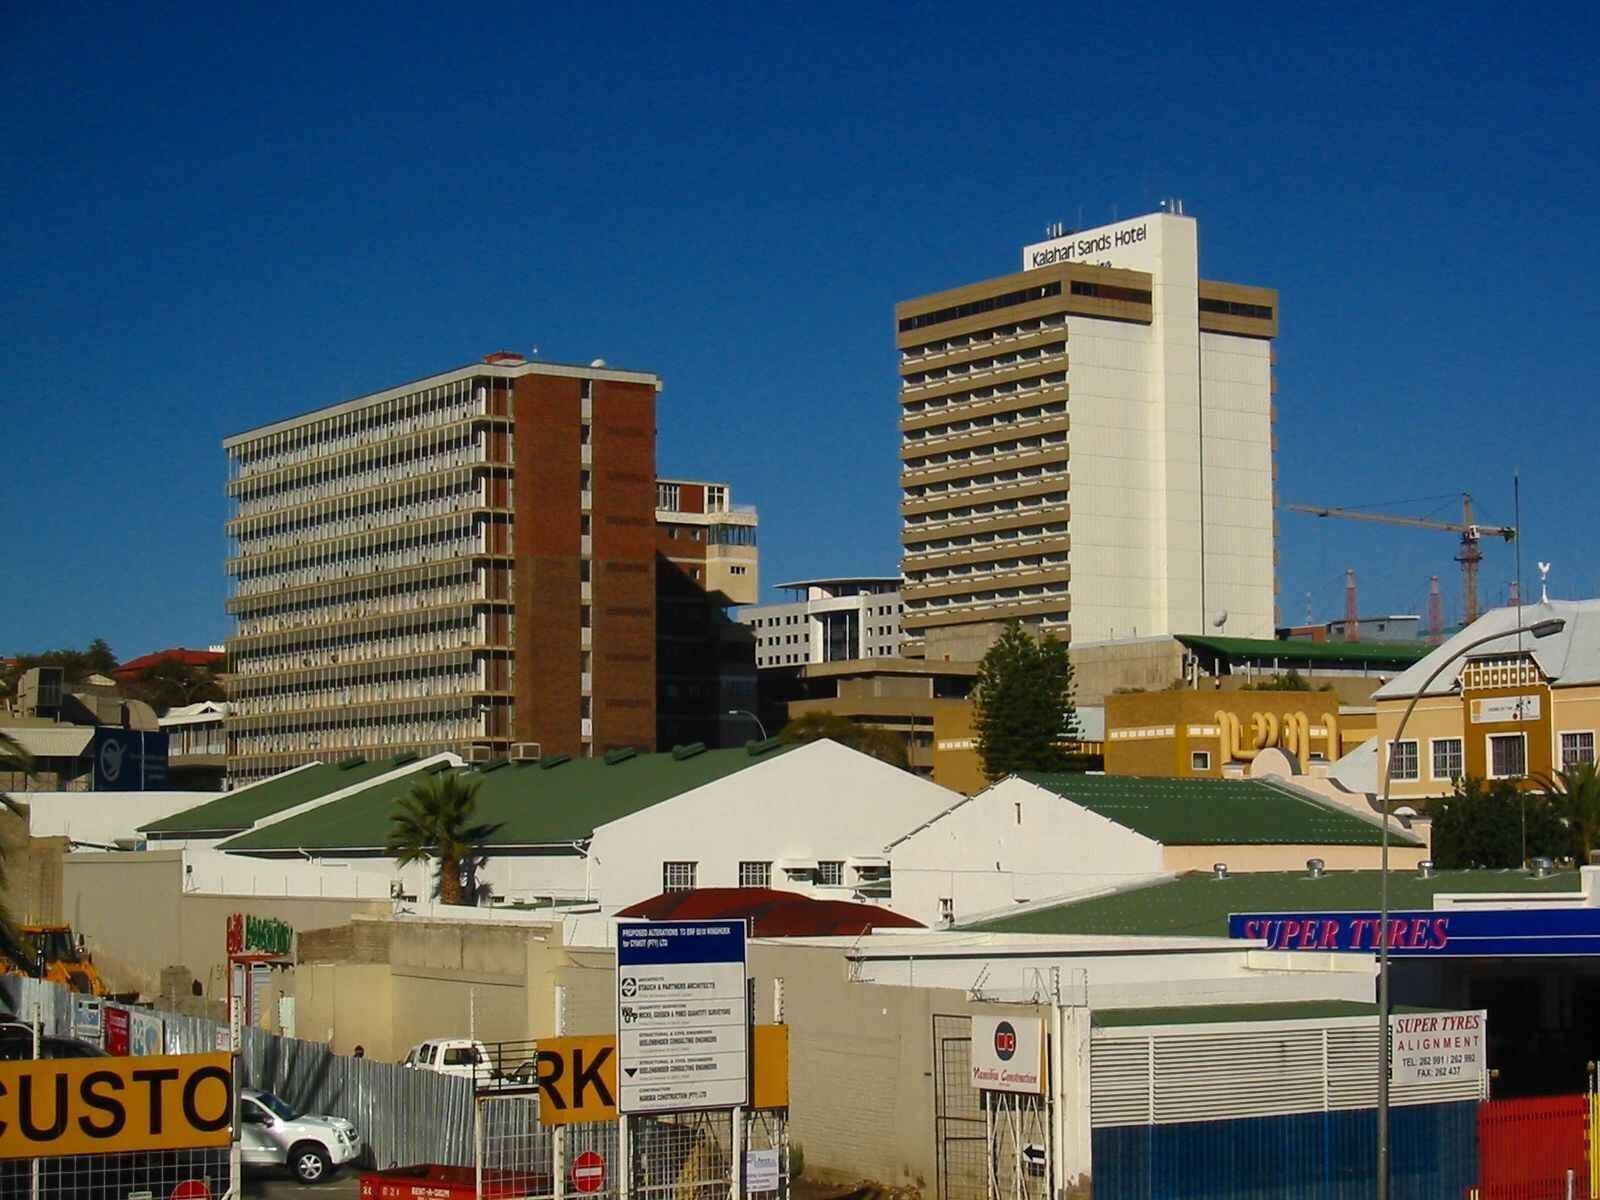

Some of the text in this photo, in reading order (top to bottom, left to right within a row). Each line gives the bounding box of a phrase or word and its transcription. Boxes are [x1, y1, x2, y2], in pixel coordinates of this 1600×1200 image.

[1032, 242, 1075, 268] Kalahari
[1077, 234, 1111, 256] Sands
[1114, 223, 1147, 247] Hotel
[1244, 918, 1449, 950] SUPER TYRES
[1396, 1015, 1480, 1034] SUPER TYRES
[1397, 1036, 1479, 1051] ALIGNMENT
[0, 1066, 232, 1142] USTO
